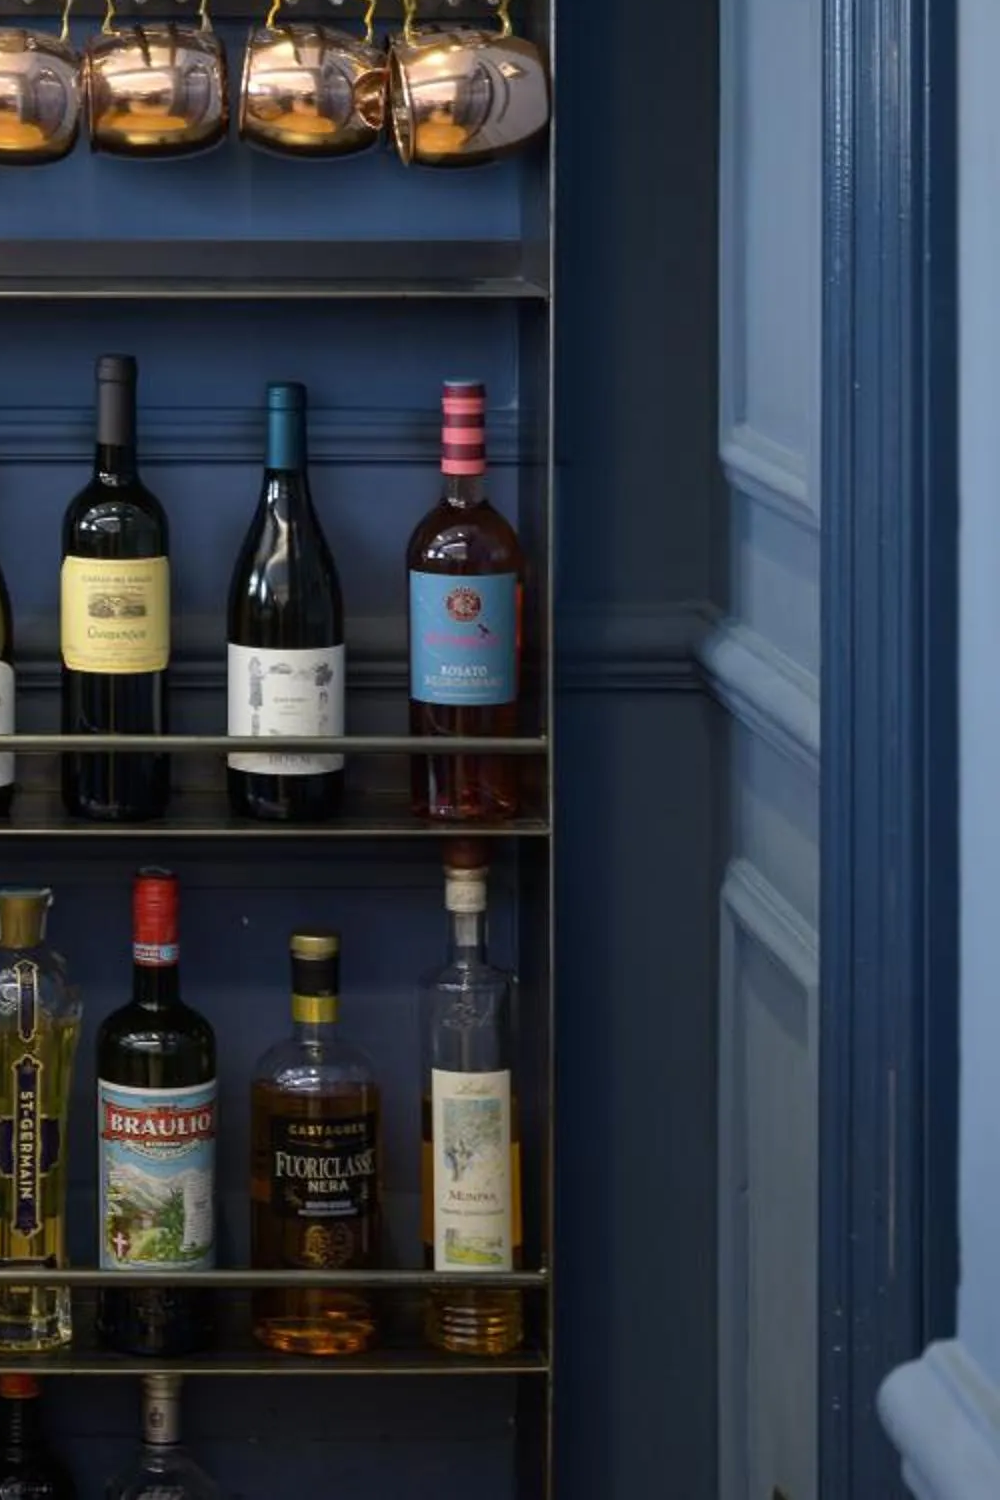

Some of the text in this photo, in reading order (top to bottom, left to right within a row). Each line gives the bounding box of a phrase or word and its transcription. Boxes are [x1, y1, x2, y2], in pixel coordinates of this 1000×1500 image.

[110, 1112, 212, 1136] BRAULIO
[19, 1091, 35, 1200] ST-GERMAIN
[307, 1180, 349, 1193] NERA
